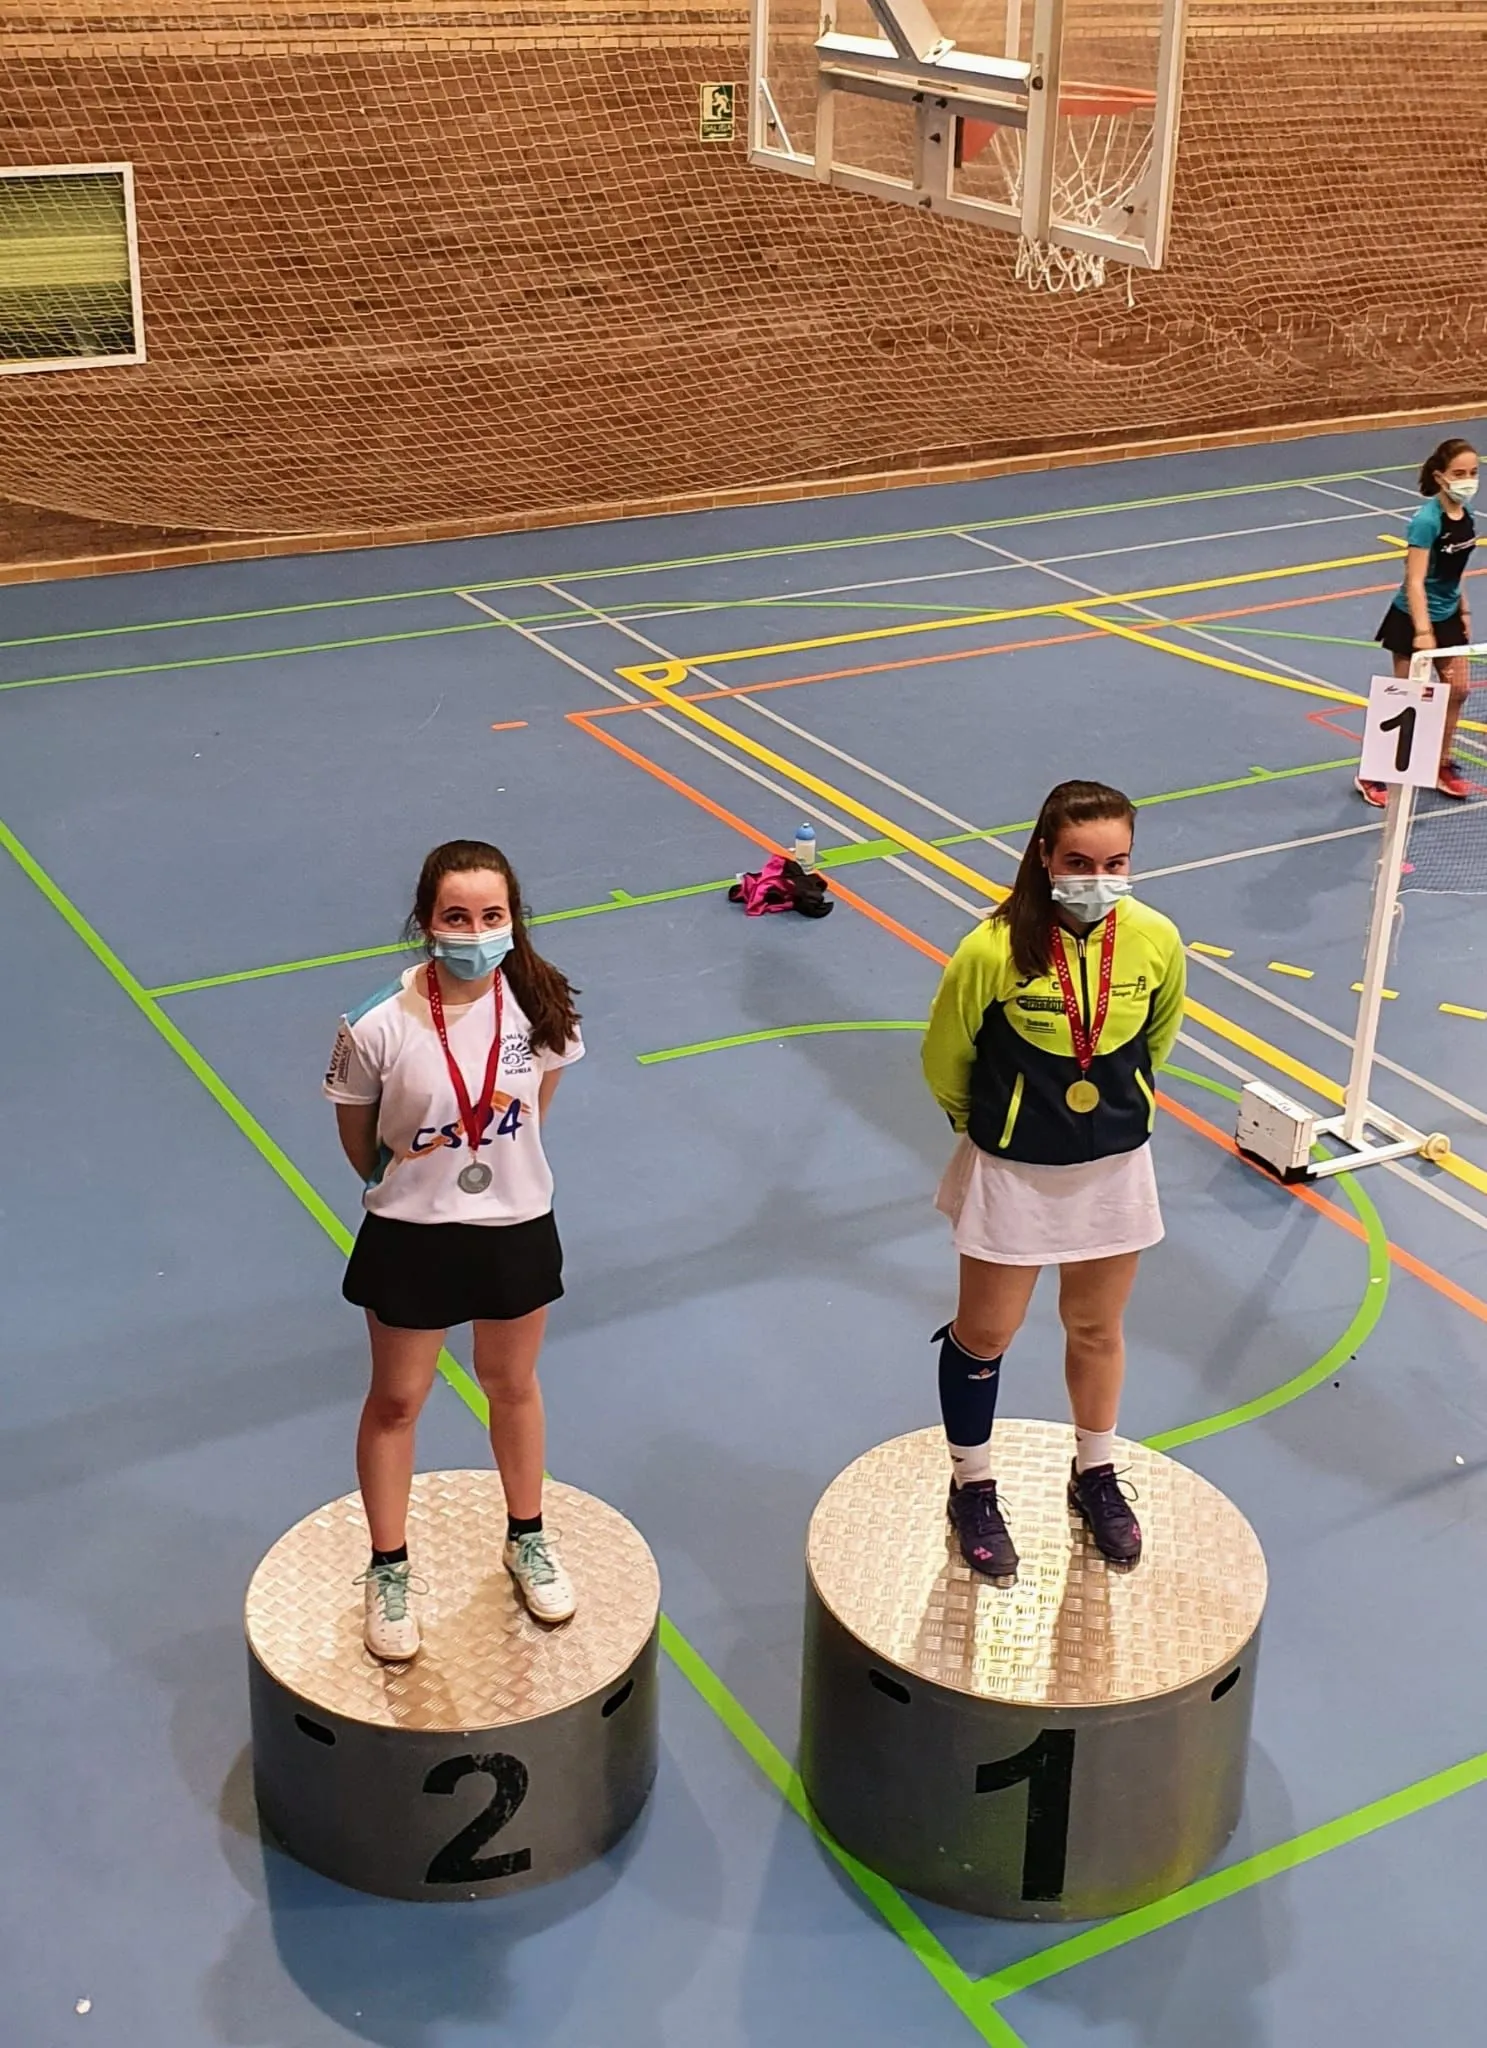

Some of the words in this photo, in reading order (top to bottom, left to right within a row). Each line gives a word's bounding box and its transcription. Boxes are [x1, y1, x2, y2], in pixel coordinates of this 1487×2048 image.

[1380, 706, 1416, 772] 1
[423, 1752, 532, 1883] 2
[975, 1729, 1076, 1902] 1
